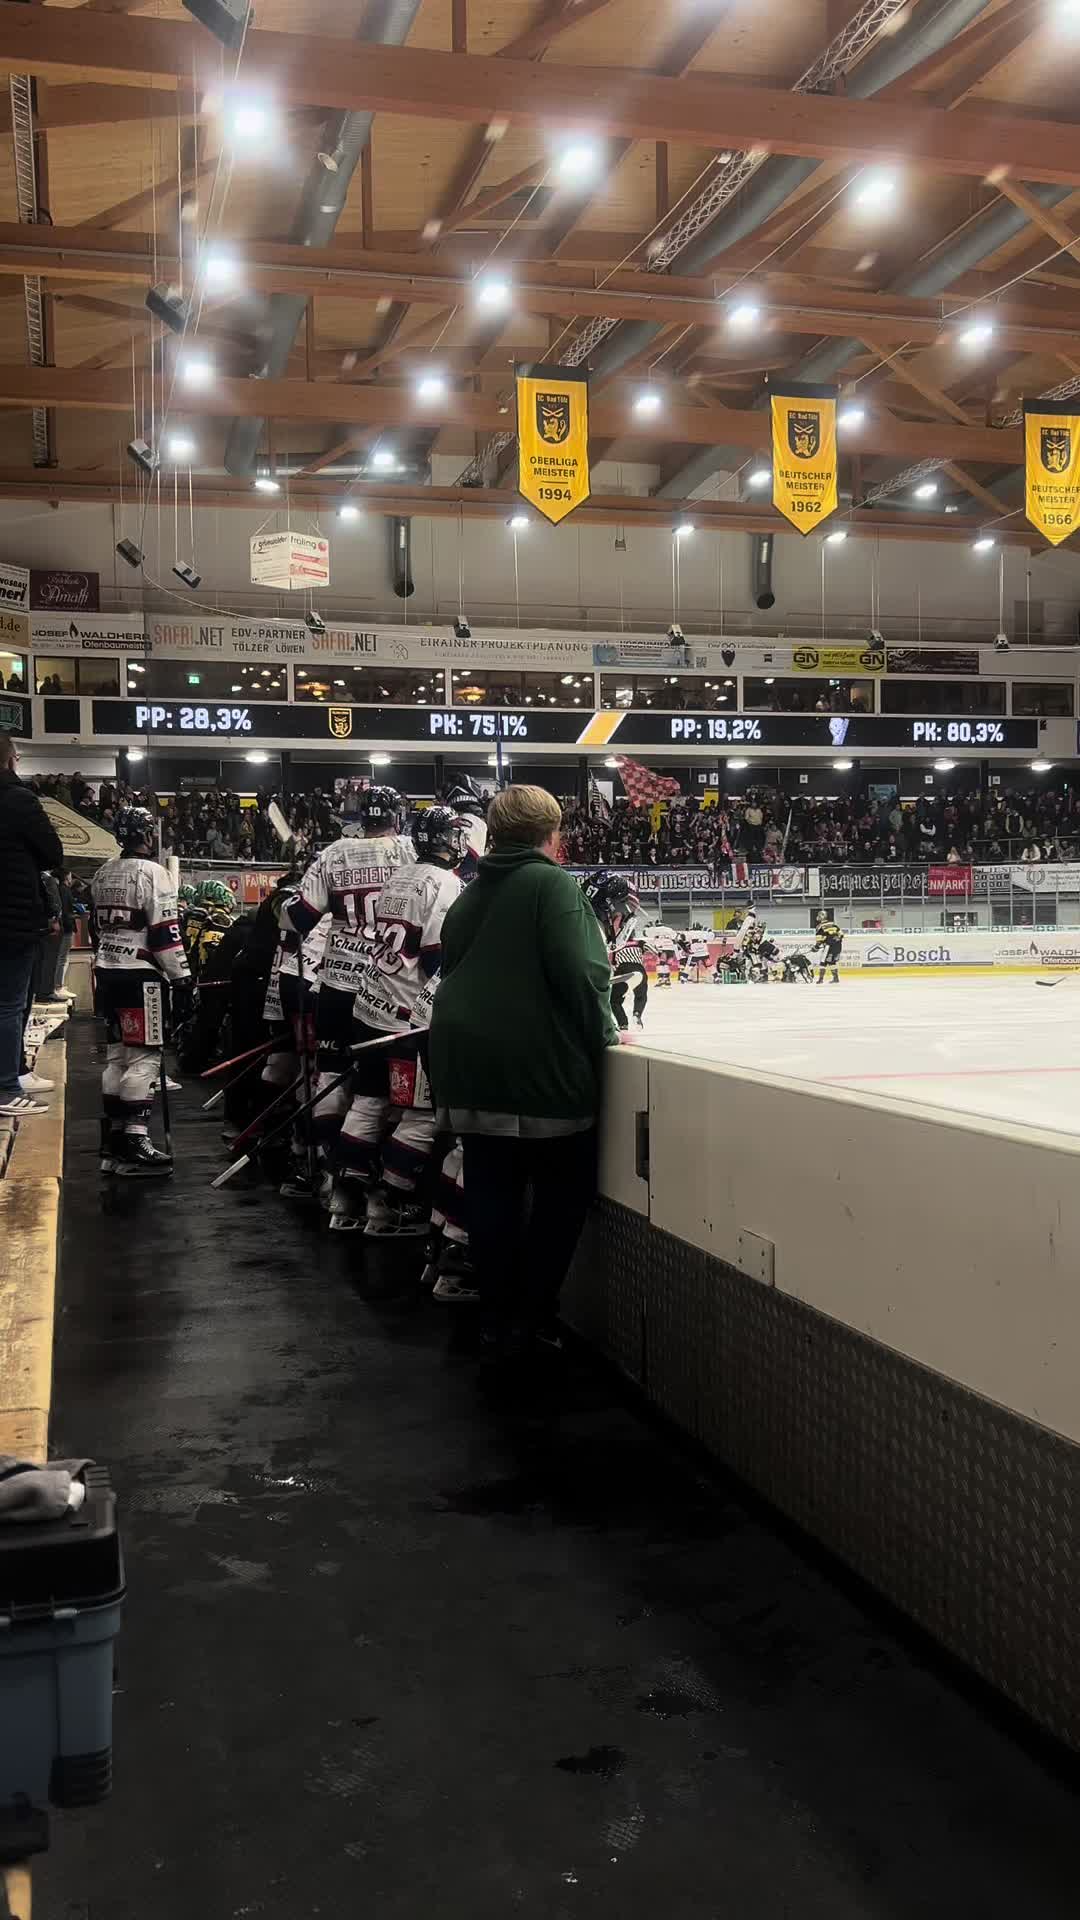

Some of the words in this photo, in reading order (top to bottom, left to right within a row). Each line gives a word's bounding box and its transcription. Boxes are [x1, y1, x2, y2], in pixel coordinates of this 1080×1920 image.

[529, 456, 579, 467] OBERLIGA
[533, 467, 576, 478] MEISTER
[780, 470, 832, 481] DEUTSCHER
[786, 481, 825, 491] MEISTER
[537, 487, 572, 501] 1994
[1038, 495, 1076, 504] MEISTER
[791, 501, 822, 513] 1962
[1042, 513, 1073, 525] 1966
[231, 627, 306, 640] EDV-PARTNER
[232, 641, 269, 653] TÖLZER
[275, 642, 305, 654] LÖWEN
[793, 652, 819, 664] GN
[859, 653, 885, 665] GN
[135, 706, 173, 730] PP:
[179, 707, 252, 732] 28,3%
[429, 713, 464, 735] PK:
[670, 718, 702, 740] PP:
[707, 719, 761, 741] 19,2%
[913, 722, 942, 743] PK:
[947, 722, 1004, 744] 80,3%
[368, 806, 382, 817] 10
[585, 885, 600, 899] 67
[893, 945, 952, 963] Bosch
